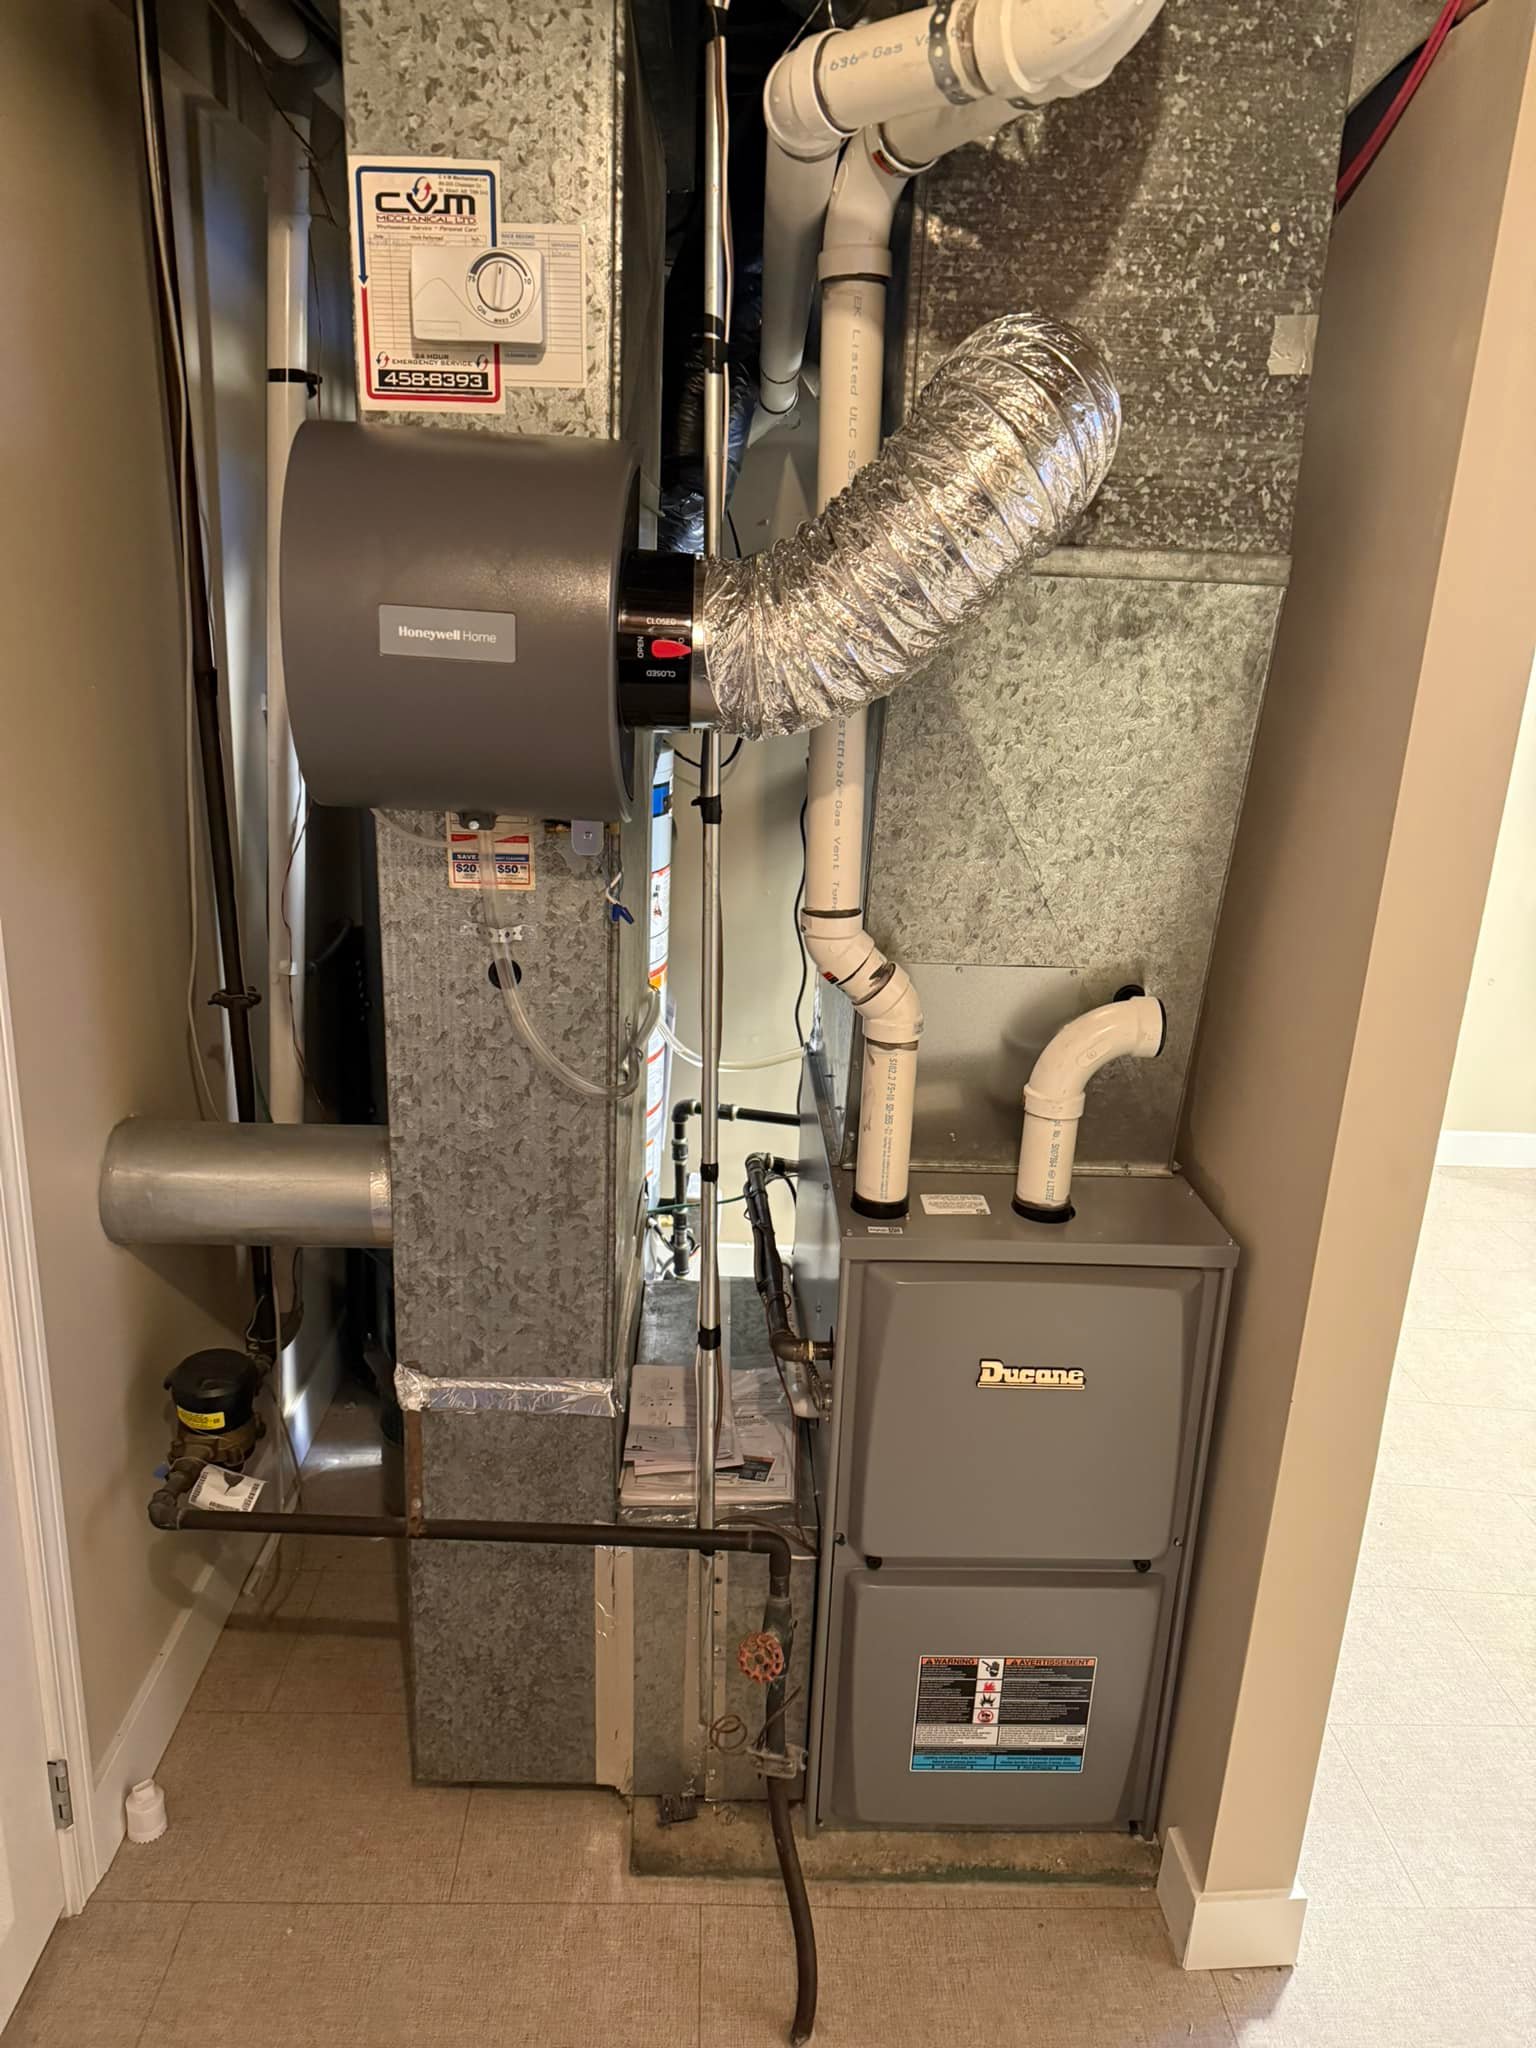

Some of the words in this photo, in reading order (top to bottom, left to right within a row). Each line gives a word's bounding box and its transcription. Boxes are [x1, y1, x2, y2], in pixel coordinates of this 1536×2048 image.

[872, 43, 904, 59] Gas
[376, 215, 453, 224] MECHANICAL
[476, 304, 487, 316] ON
[509, 308, 521, 320] OFF
[440, 359, 473, 367] SERVICE
[850, 328, 861, 397] Listed
[384, 371, 483, 388] 458-8393
[848, 406, 859, 439] ULC
[646, 617, 677, 626] CLOSED
[398, 625, 461, 642] Honeywell
[462, 630, 497, 644] Home
[636, 635, 645, 659] OPEN
[645, 669, 676, 678] CLOSED
[833, 799, 844, 827] Gas
[832, 836, 841, 870] Vent
[979, 1358, 1085, 1385] Ducane
[934, 1657, 975, 1665] WARNING
[1020, 1658, 1089, 1667] AVERTISSEMENT
